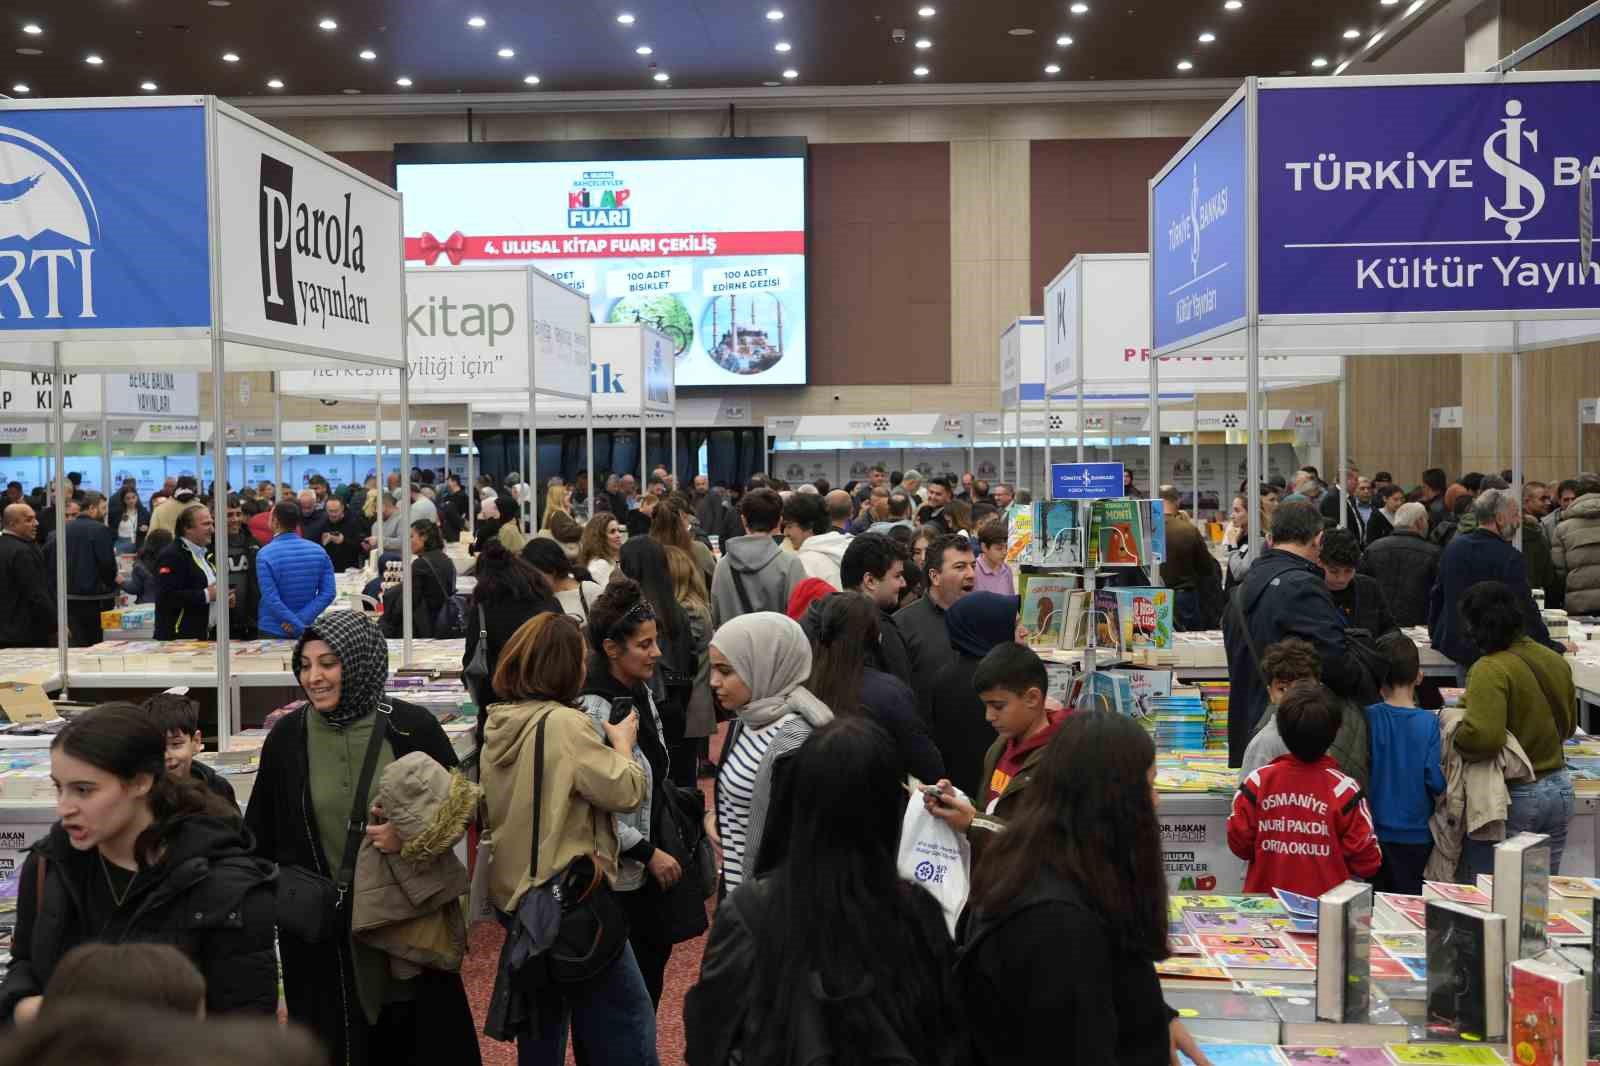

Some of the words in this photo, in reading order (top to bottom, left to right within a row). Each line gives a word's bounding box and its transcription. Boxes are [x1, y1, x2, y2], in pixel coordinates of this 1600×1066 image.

[1285, 152, 1473, 191] TÜRKİYE
[570, 210, 628, 227] FUARI
[1169, 214, 1191, 251] TÜRKİYE
[1200, 186, 1228, 230] BANKASI
[484, 241, 499, 255] 4.
[502, 240, 560, 254] ULUSAL
[563, 237, 607, 253] KİTAP
[610, 238, 655, 253] FUARI
[658, 234, 718, 255] ÇEKİLİŞ
[627, 273, 644, 281] 100
[646, 270, 671, 280] ADET
[724, 271, 741, 280] 100
[743, 269, 768, 278] ADET
[1357, 256, 1483, 289] Kültür
[629, 281, 669, 292] BİSİKLET
[712, 281, 747, 292] EDİRNE
[749, 279, 780, 289] GEZİSİ
[298, 276, 370, 329] yayınları
[1176, 295, 1191, 324] Kültür
[1192, 288, 1216, 320] Yayınları
[408, 356, 458, 380] yiliği
[31, 371, 78, 385] KAIP
[37, 390, 73, 408] KIA
[1261, 793, 1328, 815] OSMANİYE
[1175, 823, 1206, 832] HAKAN
[1258, 817, 1285, 832] NURİ
[1287, 819, 1329, 836] PAKDİL
[1262, 840, 1330, 856] ORTAOKULU
[1166, 863, 1208, 872] ELIEVLER
